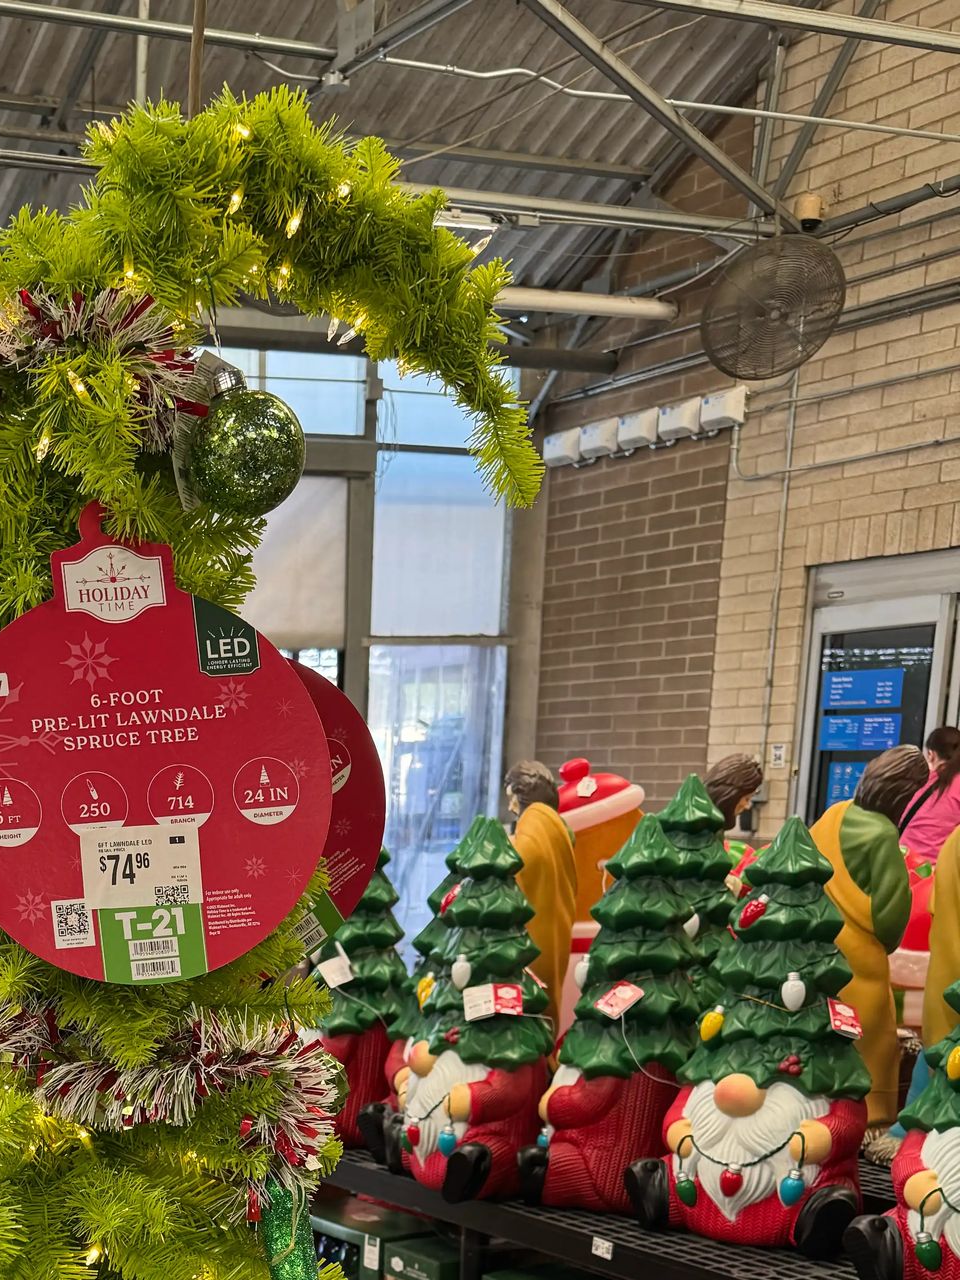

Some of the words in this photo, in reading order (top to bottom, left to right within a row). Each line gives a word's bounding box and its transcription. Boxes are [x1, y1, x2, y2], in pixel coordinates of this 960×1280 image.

[78, 584, 150, 603] HOLIDAY
[98, 601, 134, 612] TIME
[206, 638, 250, 659] LED
[207, 658, 228, 666] LONGER
[207, 663, 226, 671] ENERGY
[90, 689, 163, 708] 6-FOOT
[31, 713, 110, 733] PRE-LIT
[116, 704, 227, 726] LAWNDALE
[63, 732, 141, 751] SPRUCE
[145, 727, 199, 744] TREE
[167, 795, 194, 810] 714
[244, 790, 264, 803] 24
[269, 787, 288, 800] IN
[79, 802, 111, 818] 250
[8, 814, 21, 824] FT
[170, 817, 196, 825] BRANCH
[114, 907, 185, 940] T-21
